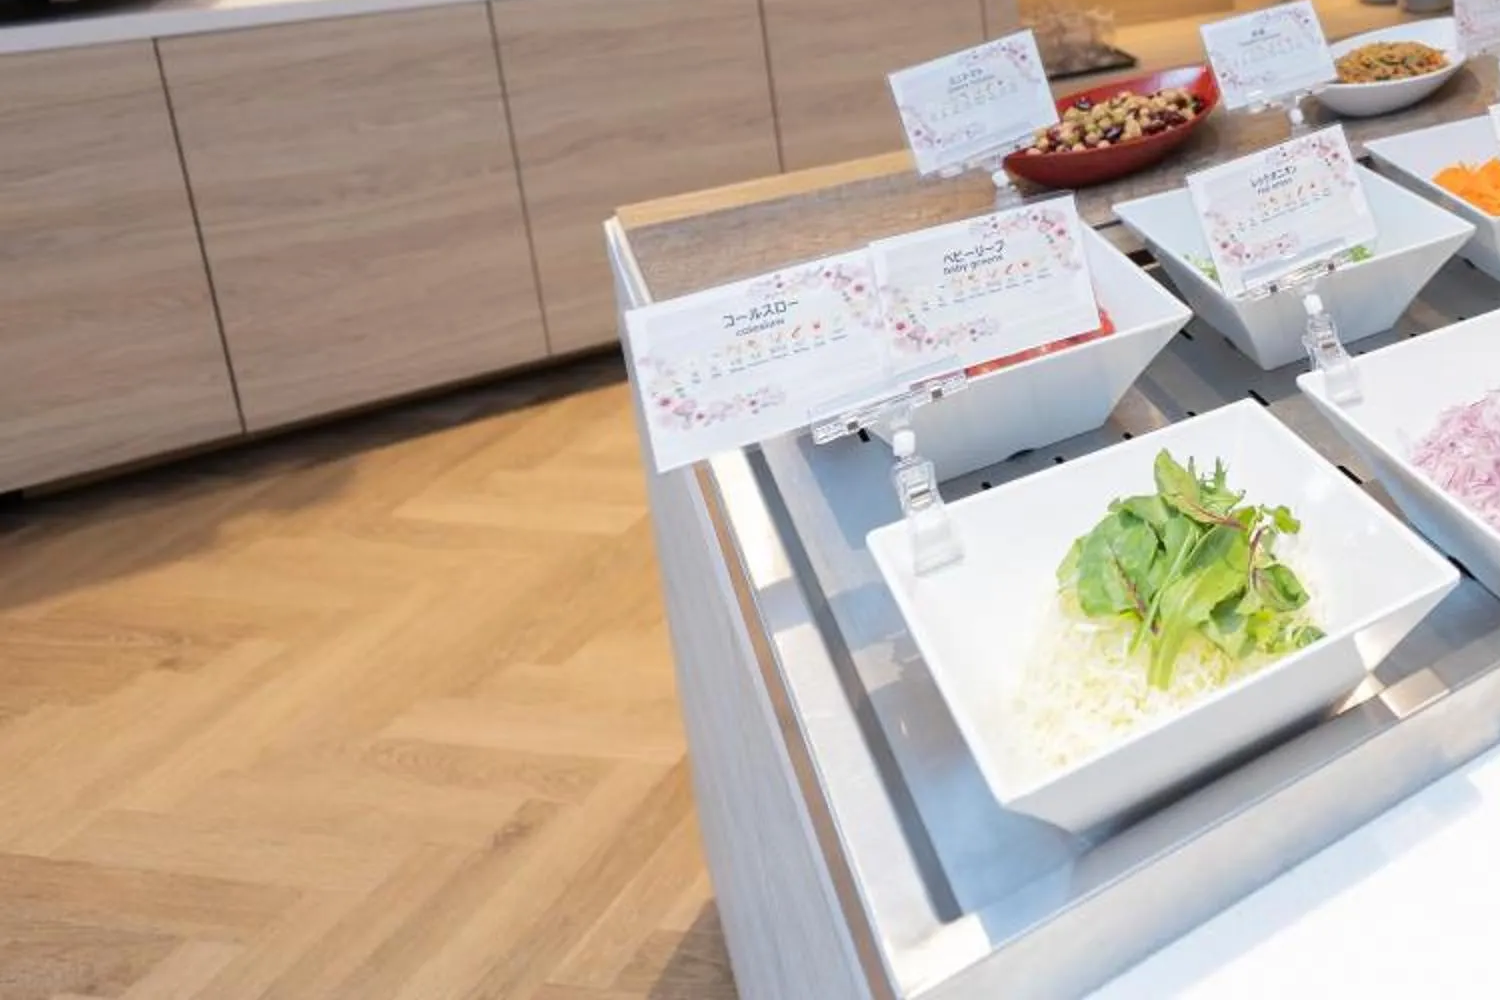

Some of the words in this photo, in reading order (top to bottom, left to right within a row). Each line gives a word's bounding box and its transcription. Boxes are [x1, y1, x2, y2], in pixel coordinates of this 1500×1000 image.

[722, 299, 799, 329] コールスロー
